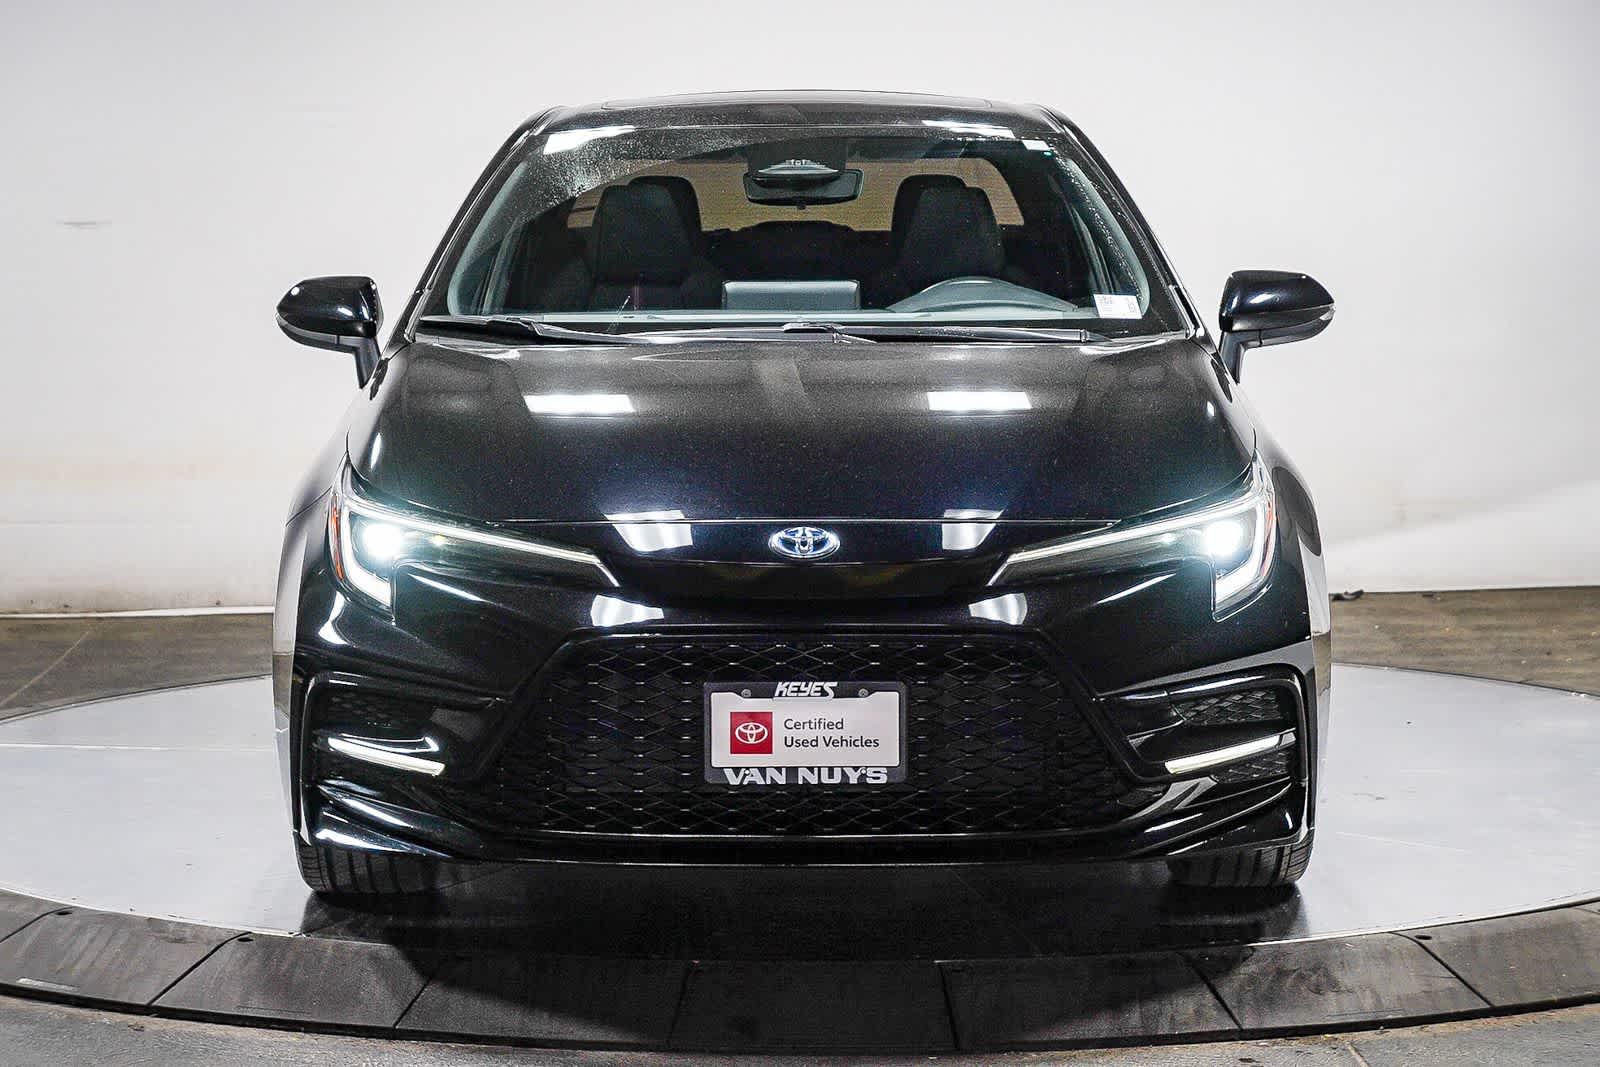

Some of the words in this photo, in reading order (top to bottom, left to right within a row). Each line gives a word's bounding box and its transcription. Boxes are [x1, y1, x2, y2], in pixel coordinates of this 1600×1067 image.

[775, 681, 838, 699] KEYES
[784, 718, 844, 730] Certified
[784, 735, 819, 748] Used
[823, 735, 880, 748] Vehicles
[723, 767, 786, 785] VAN
[799, 767, 888, 784] NUYS
